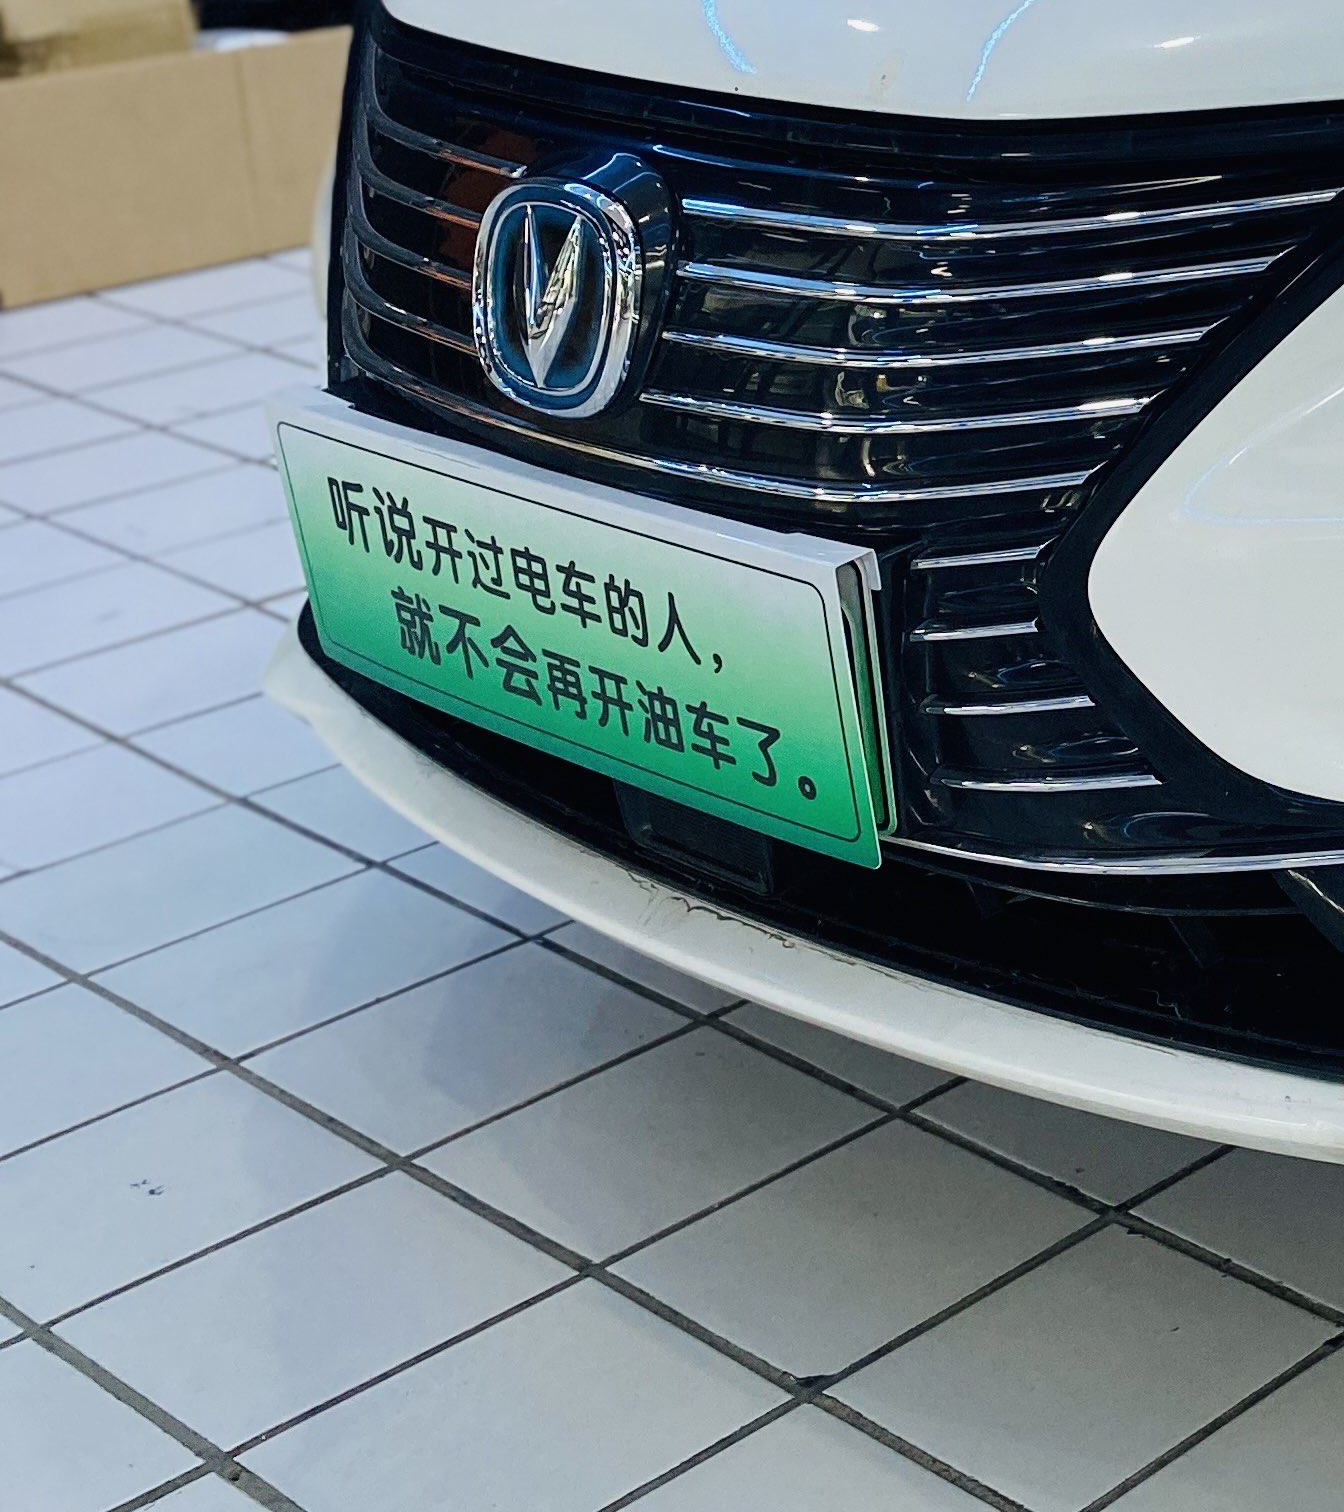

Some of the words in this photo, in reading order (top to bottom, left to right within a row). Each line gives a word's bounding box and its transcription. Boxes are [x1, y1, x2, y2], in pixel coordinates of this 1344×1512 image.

[390, 586, 816, 800] 就不会再开油车了。
